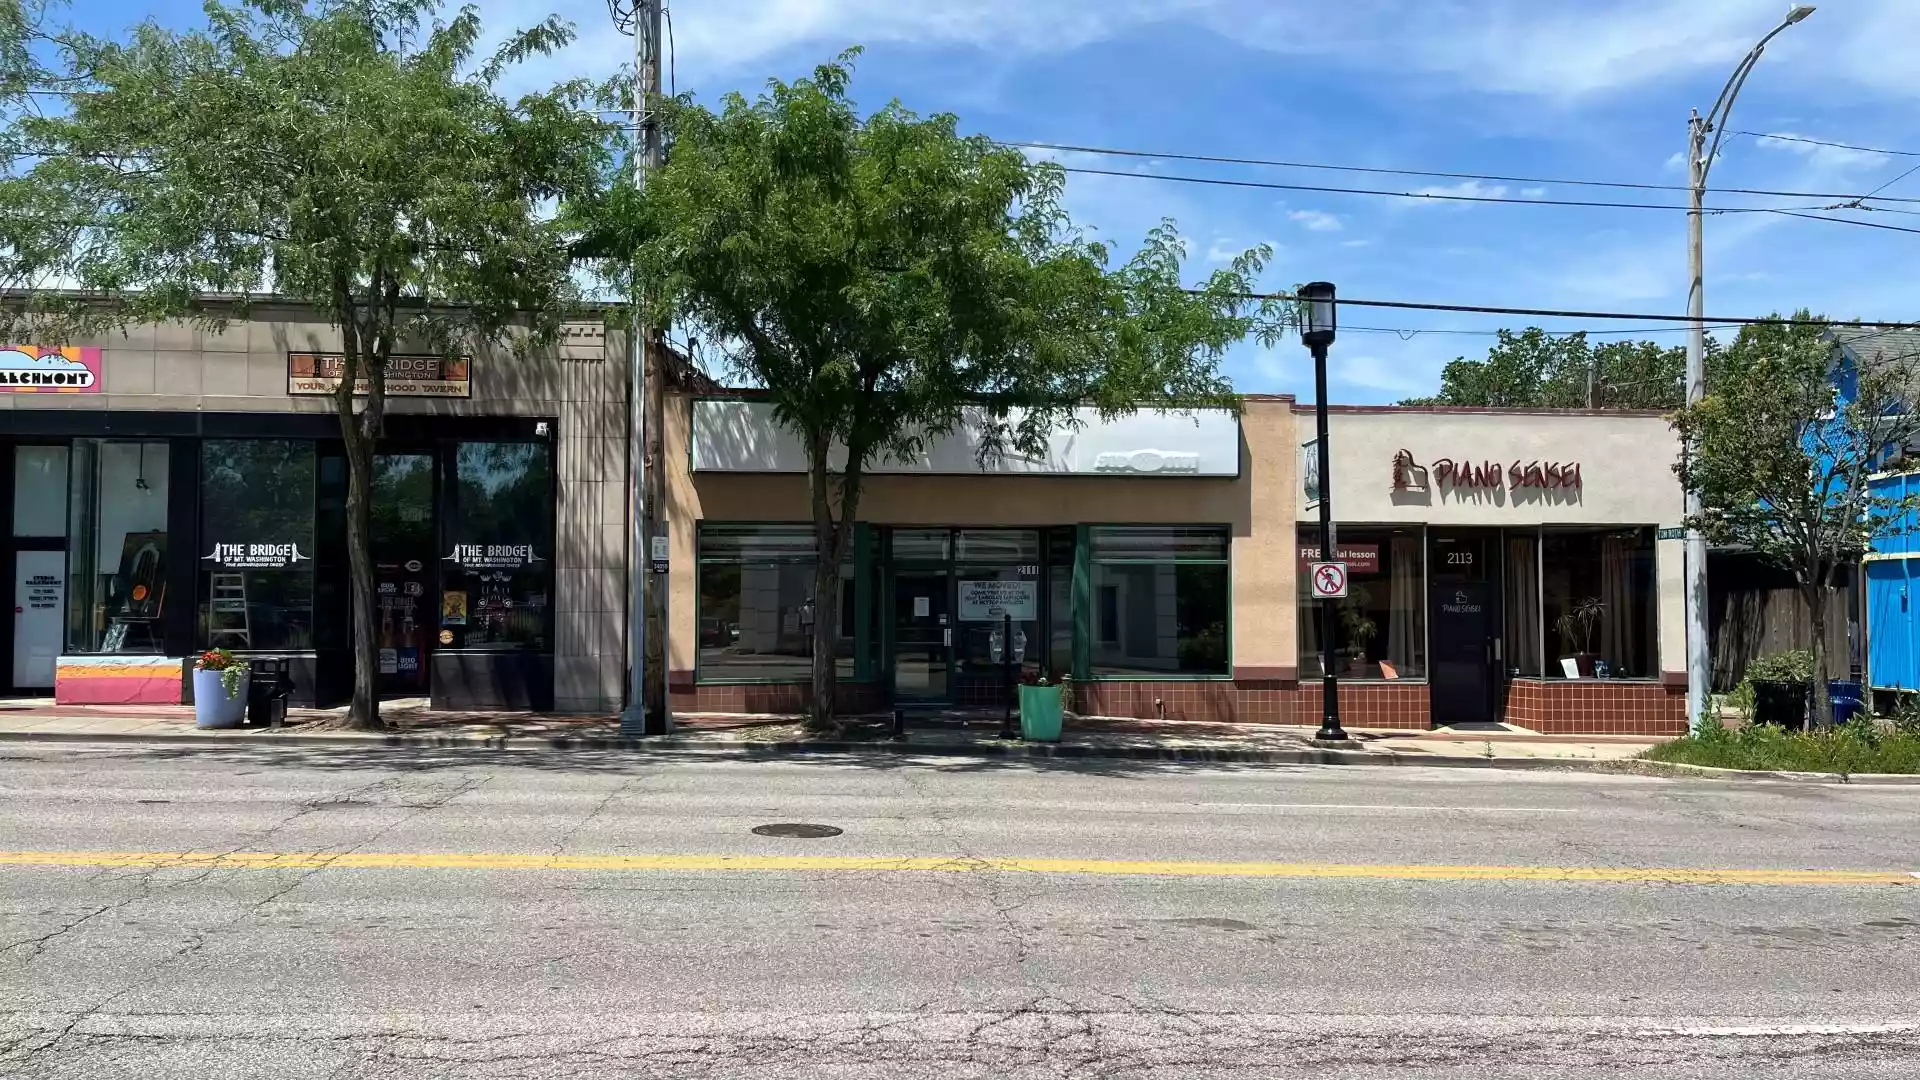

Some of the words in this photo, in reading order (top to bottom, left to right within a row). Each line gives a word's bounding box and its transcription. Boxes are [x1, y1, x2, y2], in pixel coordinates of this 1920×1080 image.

[322, 358, 346, 369] TH
[384, 359, 439, 371] RIDGE
[383, 371, 432, 379] SHINGTON
[296, 382, 325, 391] YOUR
[422, 384, 462, 393] TAVERN
[1432, 458, 1503, 489] PIANO
[1508, 460, 1581, 491] SENSEI
[221, 544, 245, 556] THE
[250, 544, 291, 556] BRIDGE
[461, 544, 484, 557] THE
[487, 545, 528, 557] BRIDGE
[1301, 548, 1321, 559] FRE
[1349, 550, 1376, 559] lesson
[1447, 552, 1473, 564] 2113
[1442, 604, 1461, 613] PIANO
